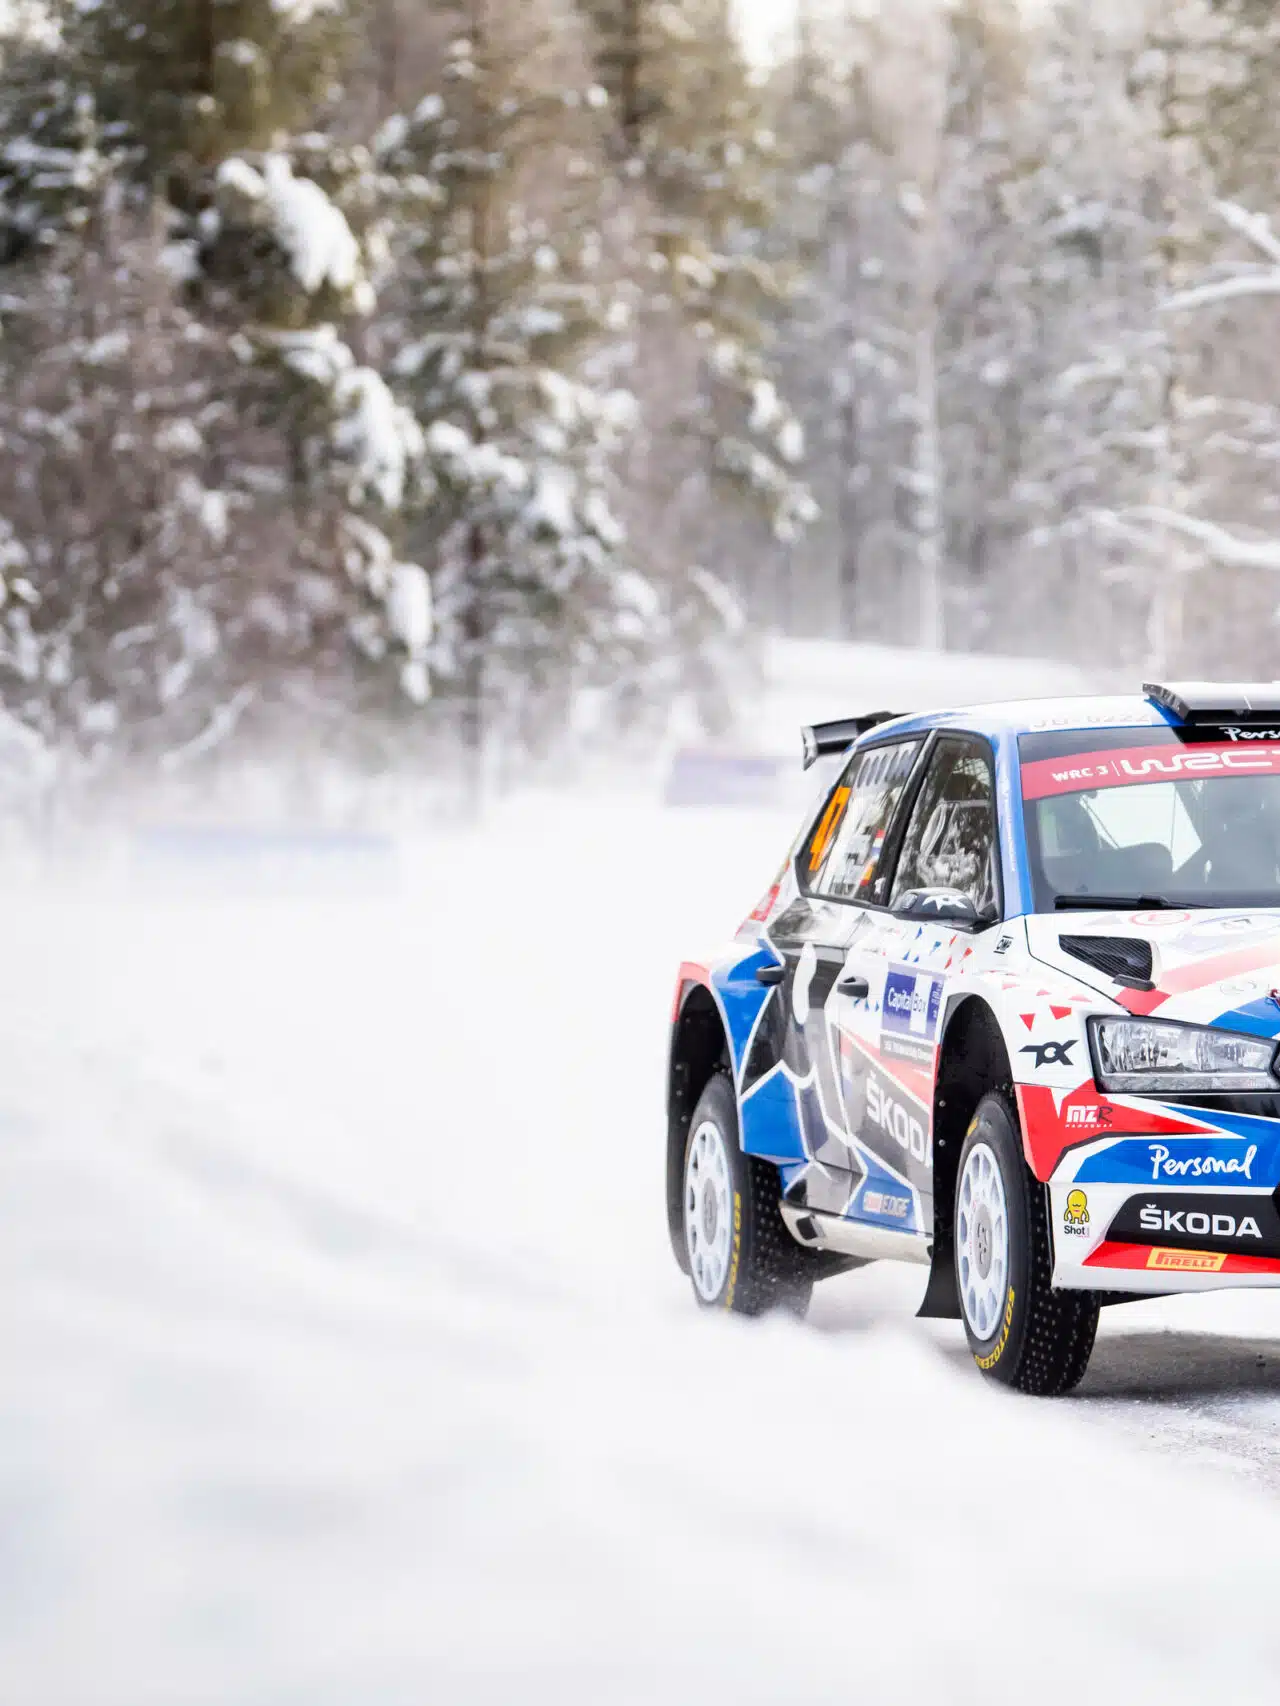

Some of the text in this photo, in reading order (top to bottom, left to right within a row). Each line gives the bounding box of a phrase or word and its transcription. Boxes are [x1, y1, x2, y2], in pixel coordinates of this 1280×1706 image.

[1051, 764, 1109, 782] WRC 3
[1148, 1143, 1258, 1180] Personal
[1063, 1225, 1086, 1236] Shot
[1139, 1203, 1263, 1238] ŠKODA
[1155, 1252, 1219, 1269] PIRELLI
[973, 1285, 1015, 1369] SOTTOZE
